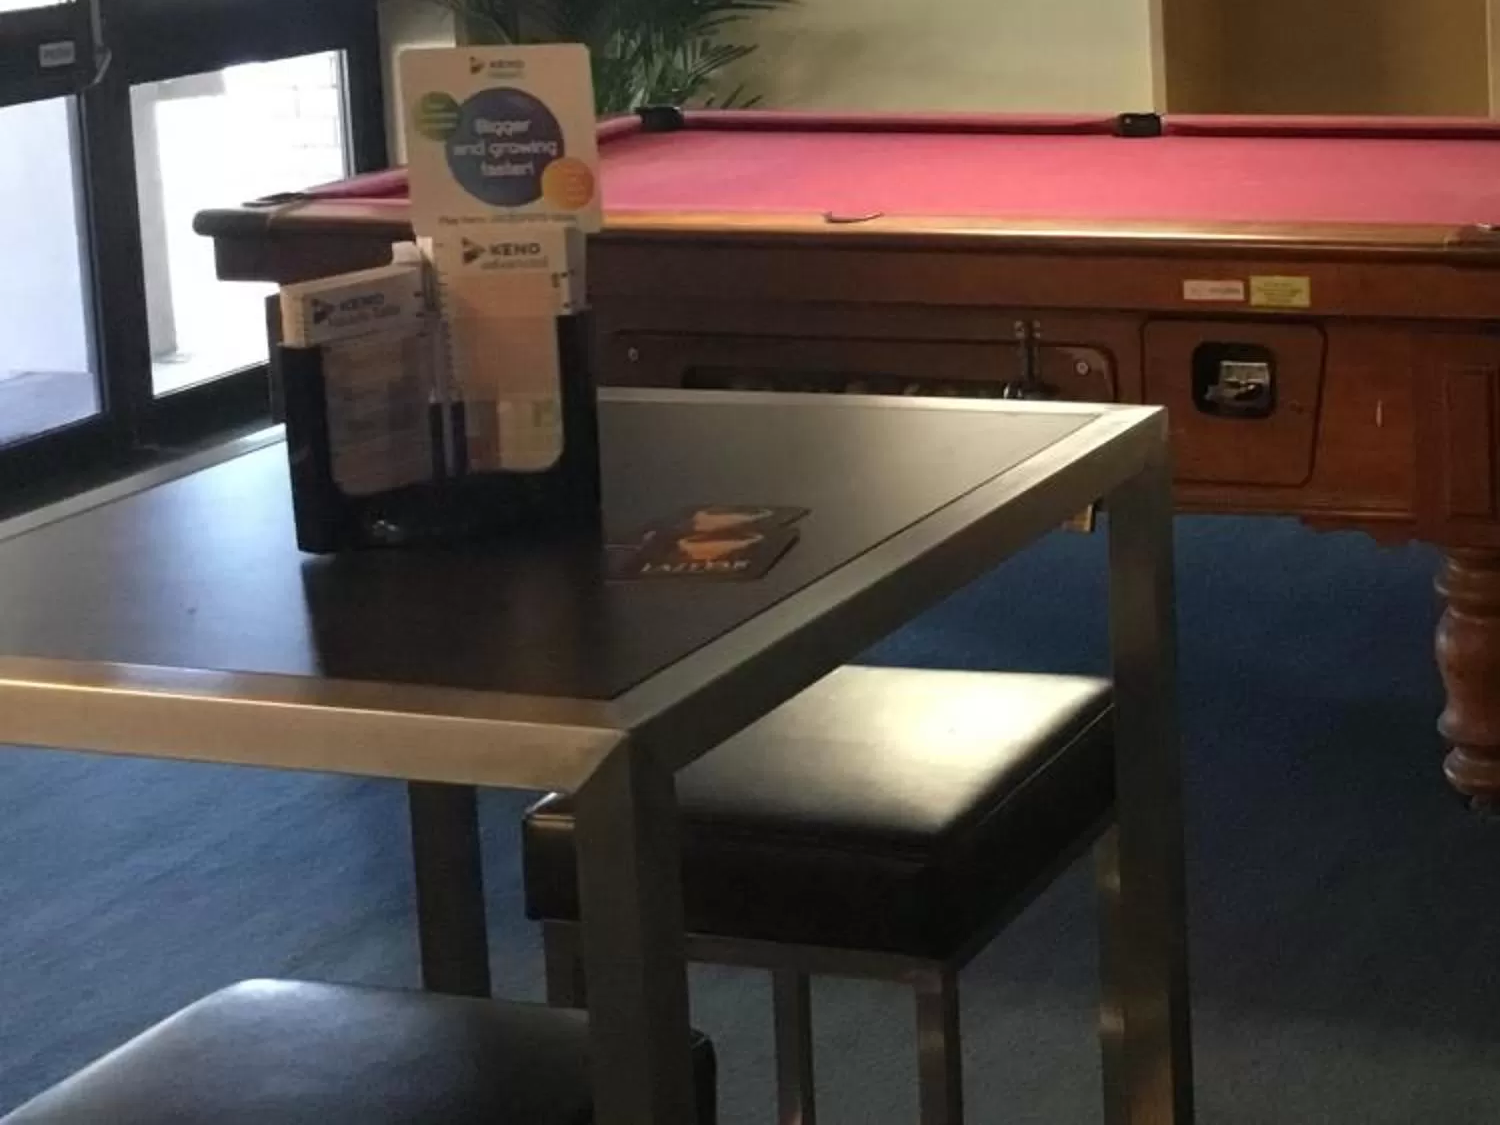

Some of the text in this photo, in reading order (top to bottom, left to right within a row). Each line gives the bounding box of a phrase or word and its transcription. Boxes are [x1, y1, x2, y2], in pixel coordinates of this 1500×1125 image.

[474, 117, 533, 137] Bigger
[453, 139, 559, 159] and growing
[489, 242, 542, 257] KENO
[339, 292, 385, 312] KENO
